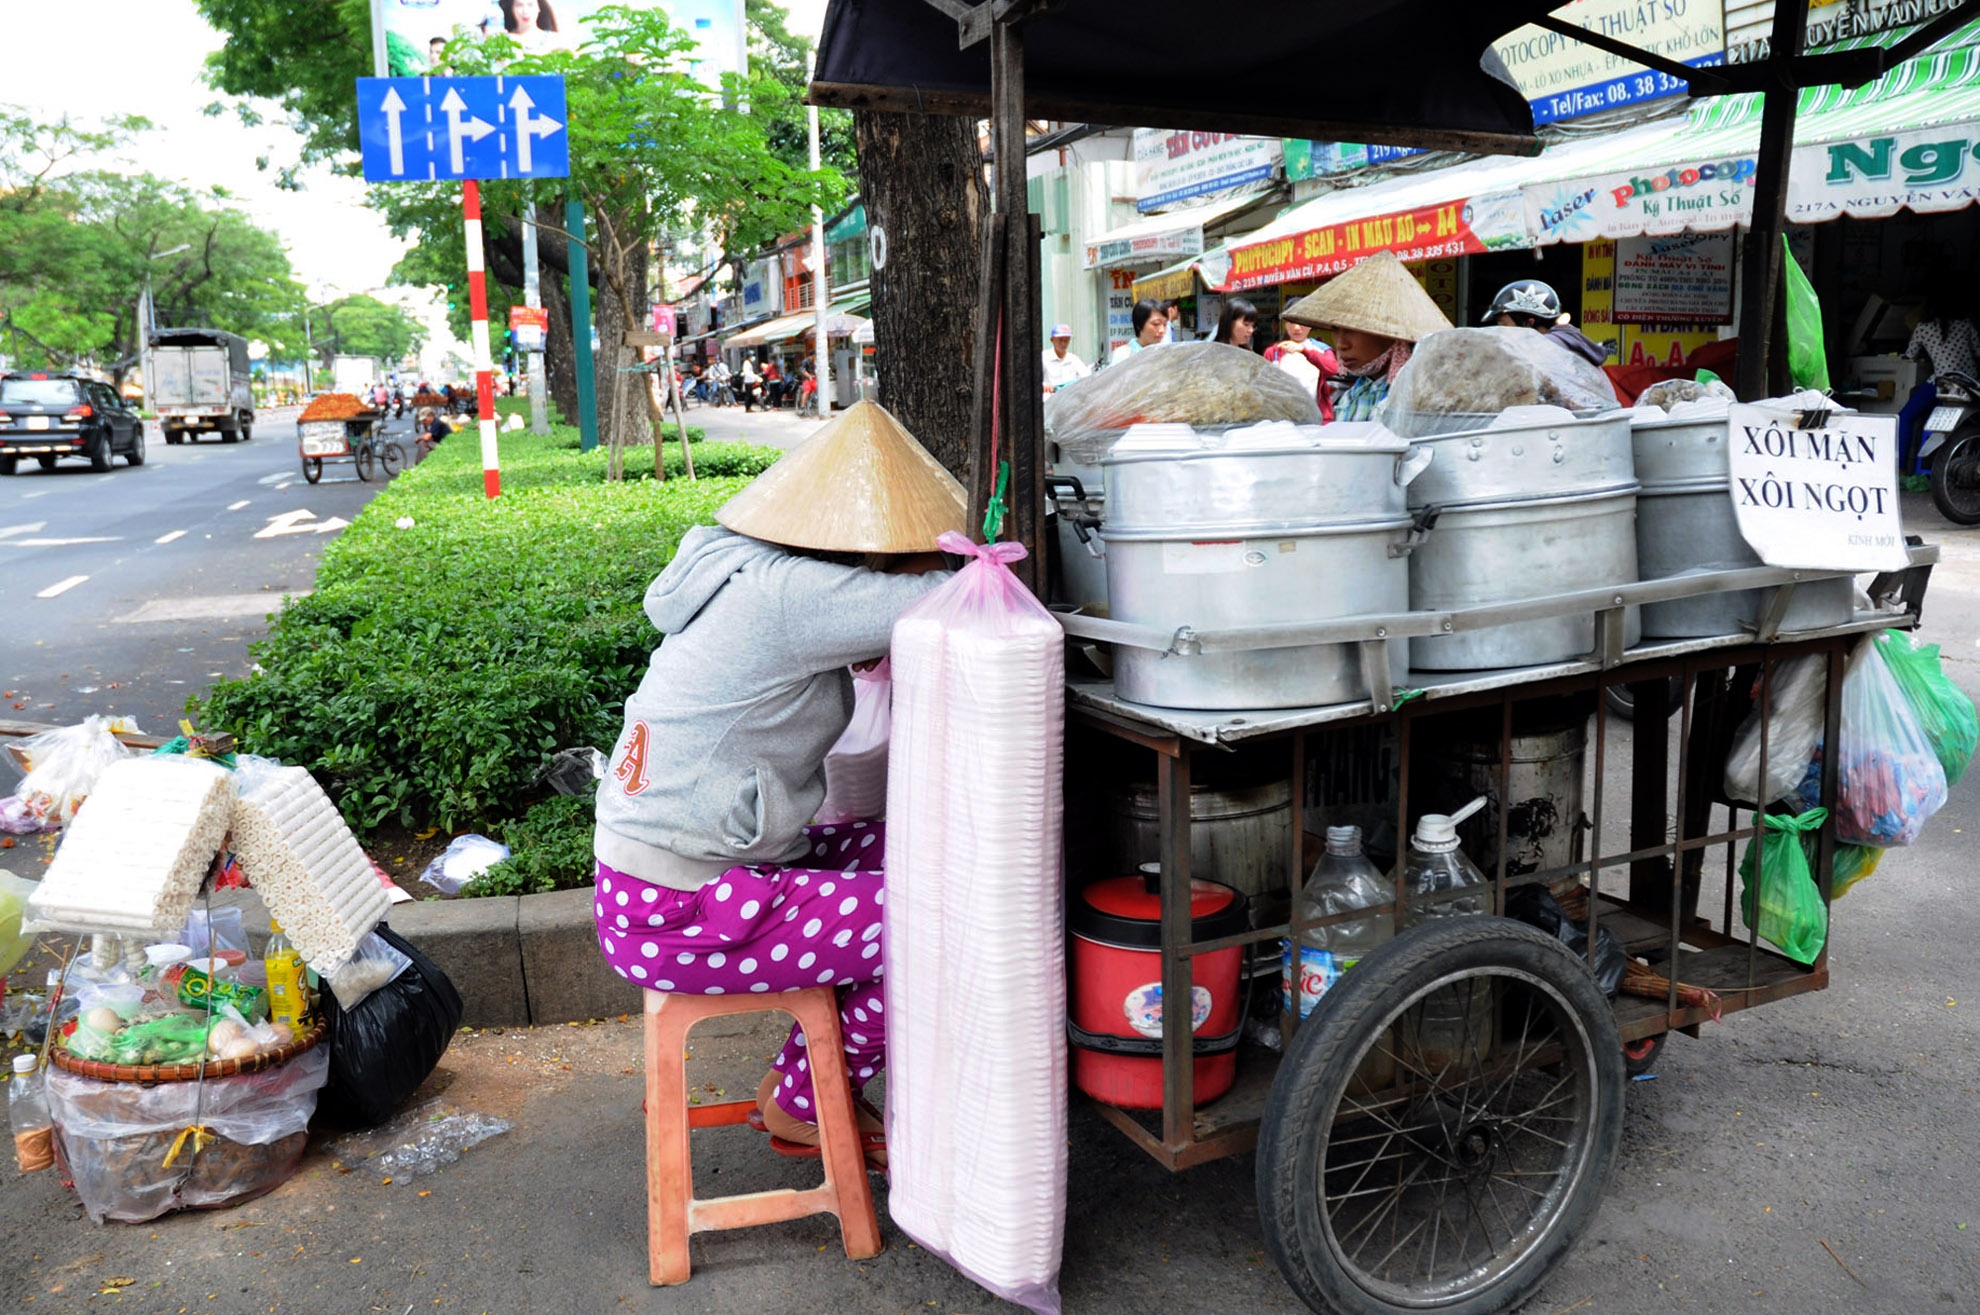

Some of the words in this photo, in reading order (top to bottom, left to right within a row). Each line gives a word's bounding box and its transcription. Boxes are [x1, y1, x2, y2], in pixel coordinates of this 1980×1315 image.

[1550, 91, 1604, 116] Tel/Fax:
[1636, 76, 1655, 96] 38
[1611, 158, 1757, 209] photocop
[1643, 199, 1660, 217] Kỹ
[1666, 195, 1712, 212] Thuật
[1720, 189, 1742, 206] Số
[1795, 202, 1837, 212] 217A
[1847, 191, 1932, 207] NGUYỄN
[1540, 187, 1595, 230] Laser
[1235, 239, 1294, 274] PHOTOCOPY
[1304, 229, 1335, 259] SCAN
[1346, 225, 1360, 251] IN
[1362, 214, 1392, 248] MÀU
[1437, 206, 1458, 237] A4
[1316, 262, 1332, 274] P.4,
[1333, 260, 1347, 272] Q.5
[1424, 244, 1445, 258] 335
[1445, 241, 1465, 255] 431
[1650, 236, 1700, 254] Laser
[1743, 420, 1797, 457] XÔI
[1806, 430, 1876, 470] MẶN
[1739, 471, 1795, 509] XÔI
[1804, 483, 1888, 520] NGỌT
